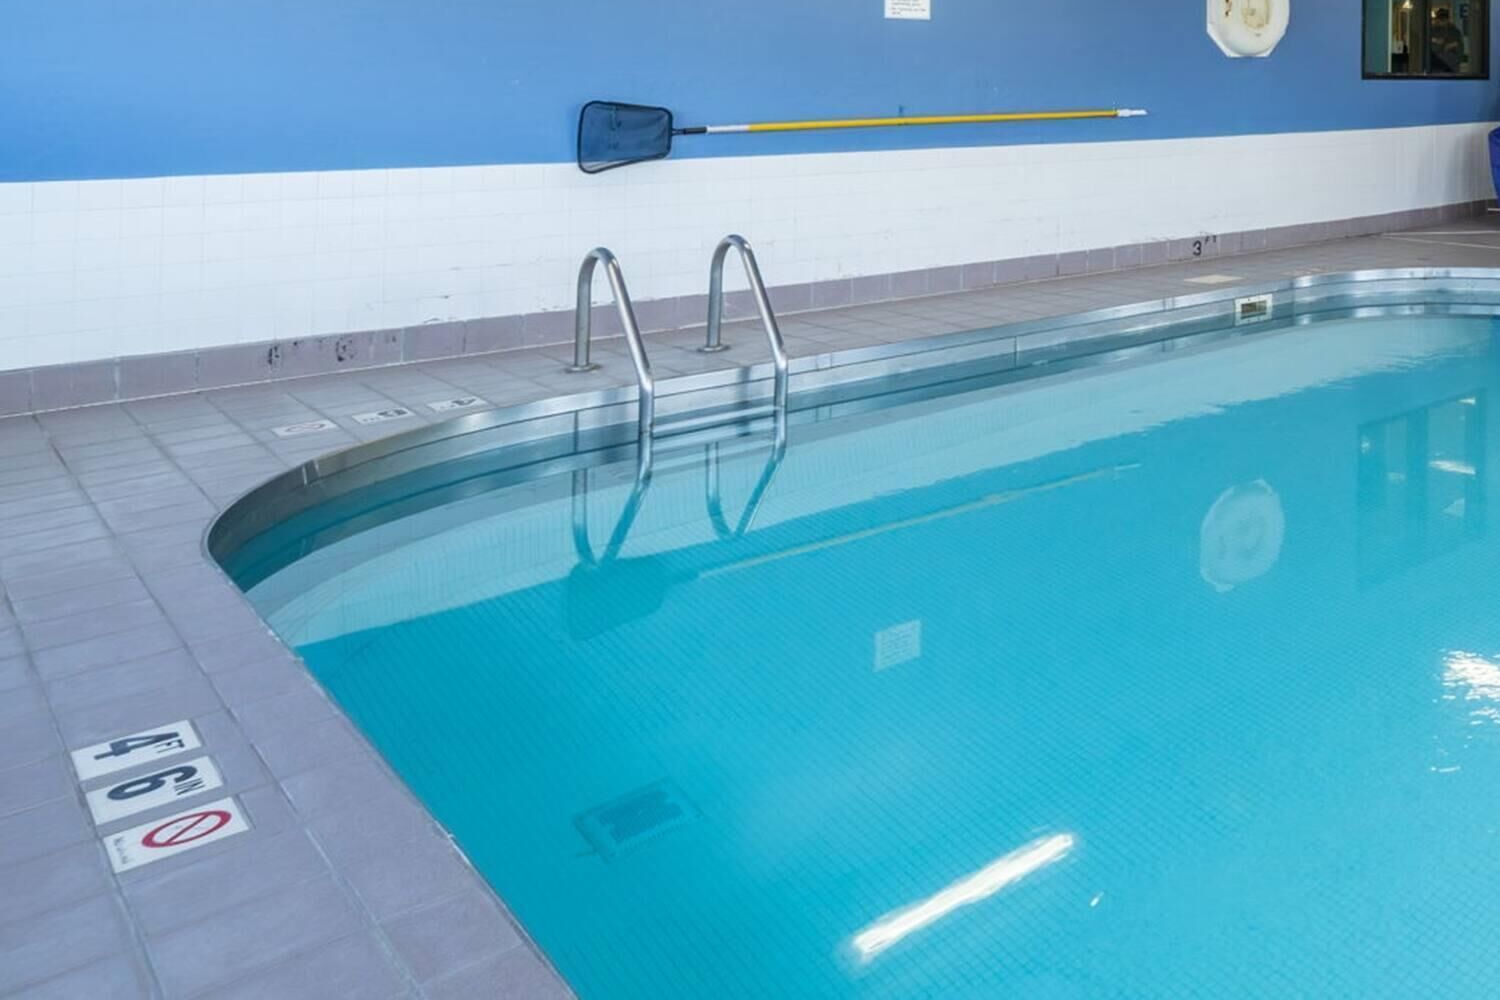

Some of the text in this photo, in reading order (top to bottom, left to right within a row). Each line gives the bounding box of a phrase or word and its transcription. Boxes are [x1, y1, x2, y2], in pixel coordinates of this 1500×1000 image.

[1193, 240, 1202, 256] 3
[94, 732, 185, 760] 4 FT
[107, 765, 206, 801] 6 IN
